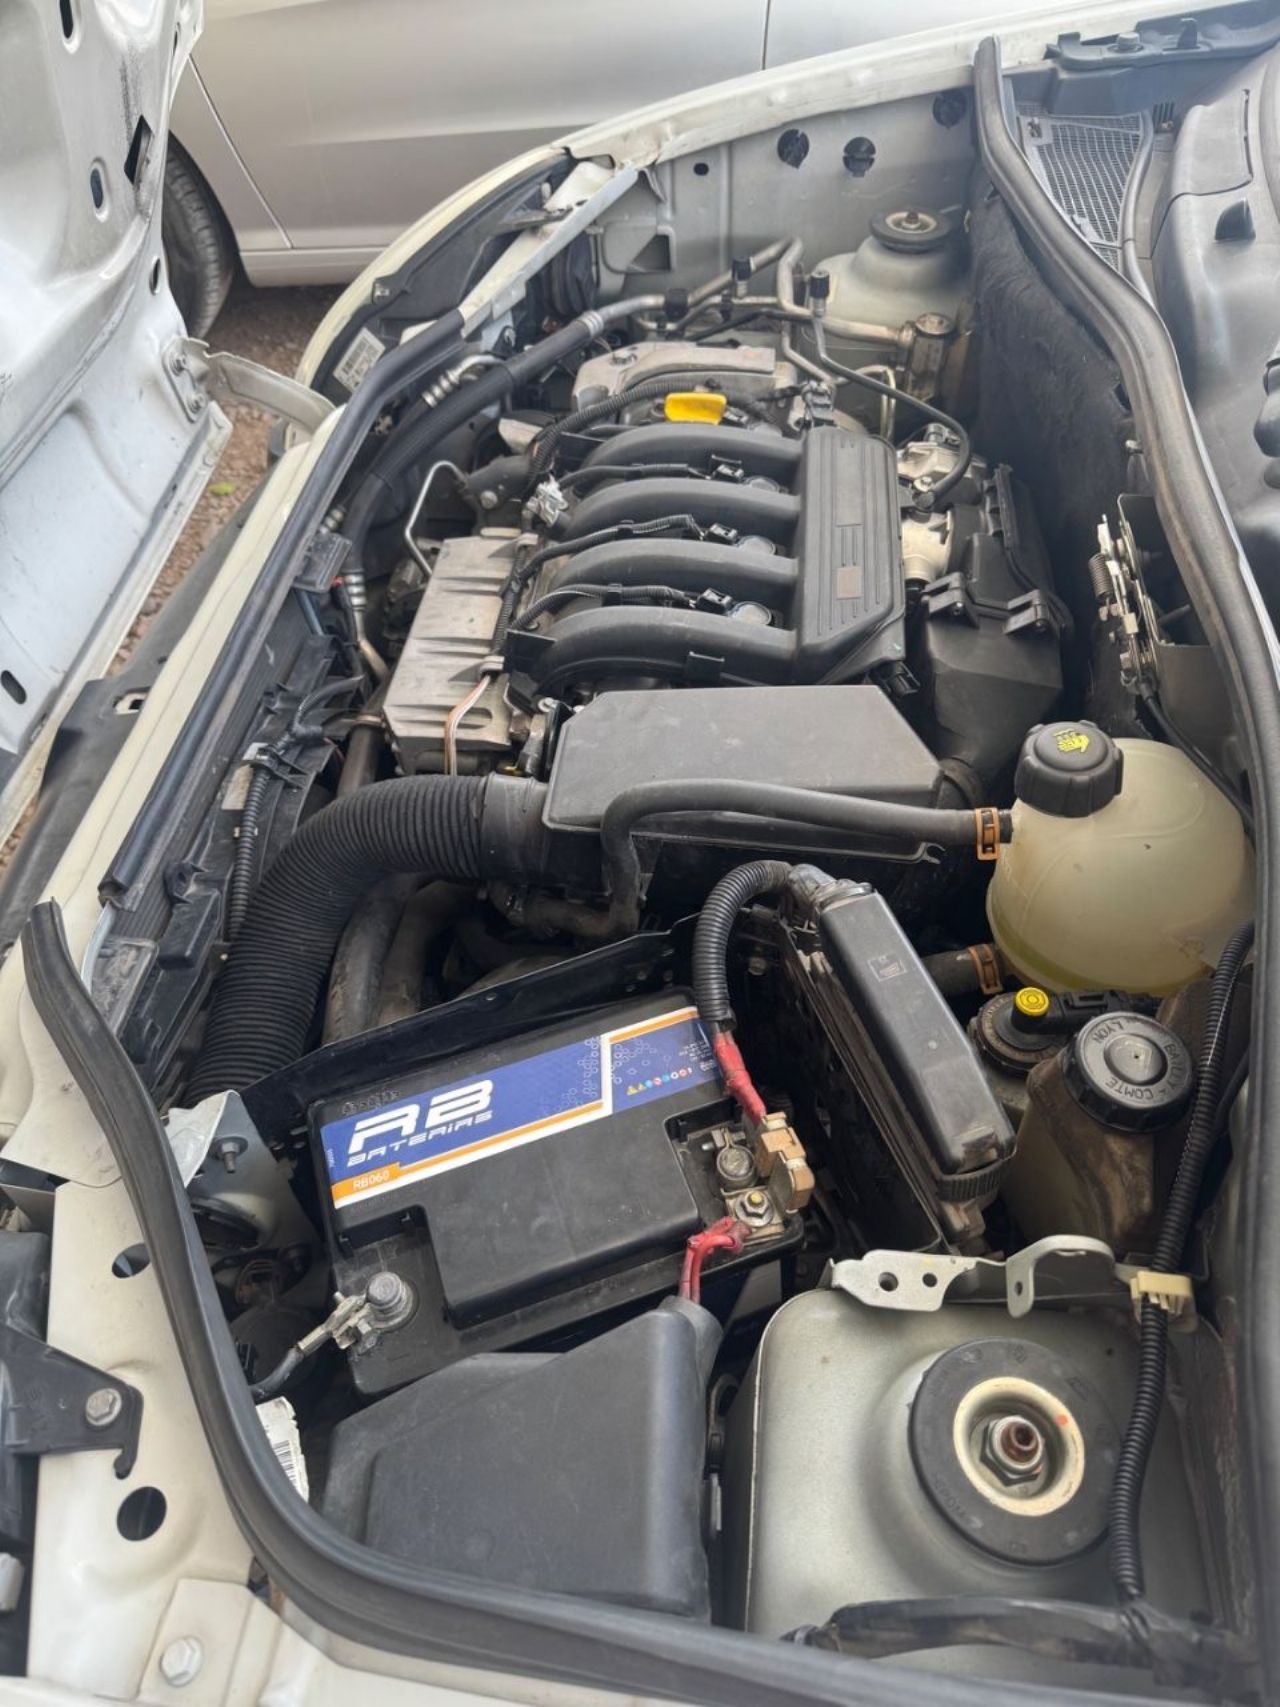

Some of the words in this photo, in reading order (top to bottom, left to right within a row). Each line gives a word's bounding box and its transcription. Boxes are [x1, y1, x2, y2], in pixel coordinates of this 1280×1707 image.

[1105, 1077, 1154, 1100] COMTE
[348, 1079, 493, 1154] RB
[352, 1170, 390, 1190] RB060
